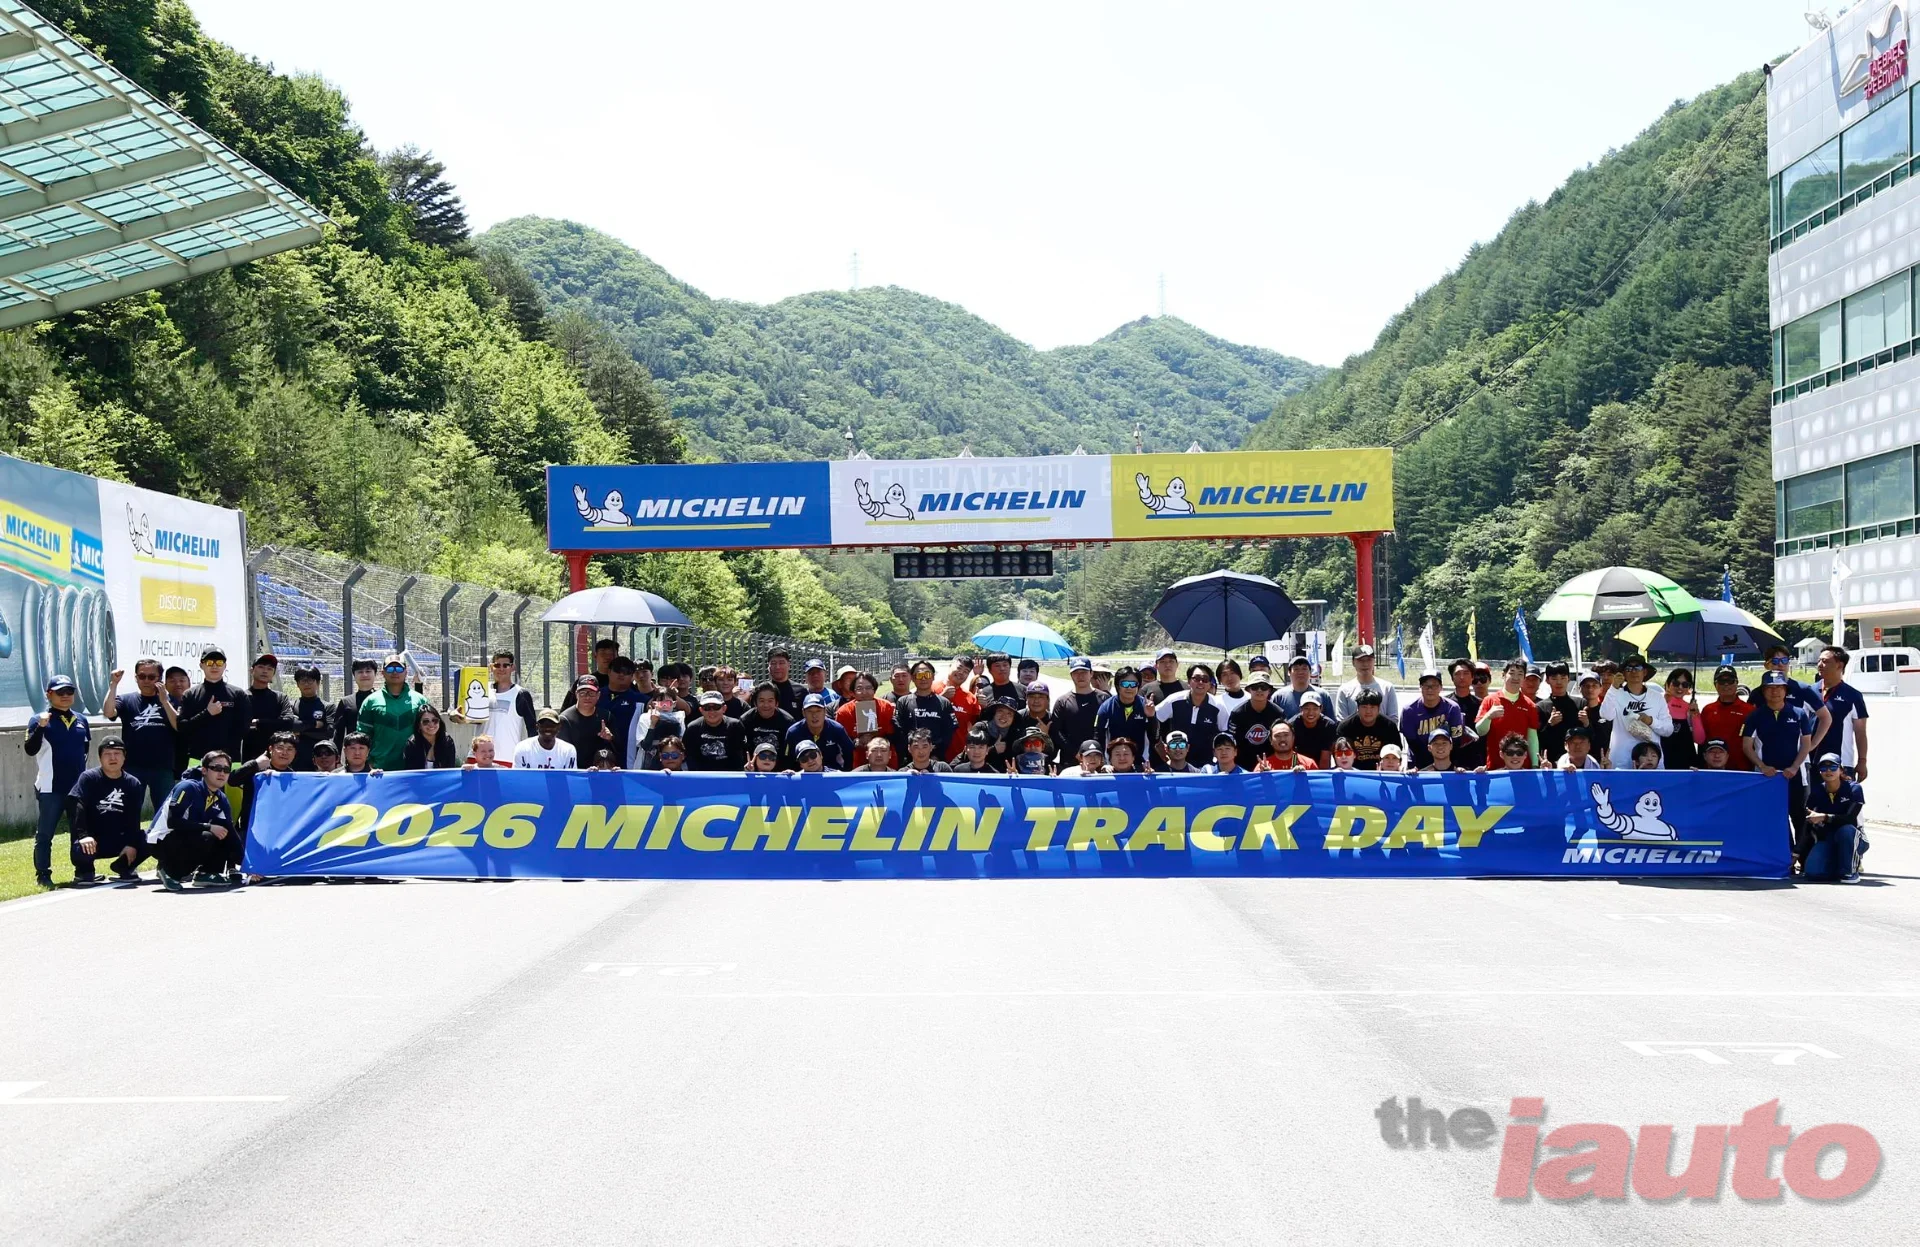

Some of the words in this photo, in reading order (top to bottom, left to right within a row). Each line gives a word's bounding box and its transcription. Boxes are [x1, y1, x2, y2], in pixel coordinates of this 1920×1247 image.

[917, 489, 1086, 513] MICHELIN
[1198, 482, 1368, 506] MICHELIN
[636, 496, 806, 519] MICHELIN
[6, 513, 61, 553] MICHELIN
[155, 529, 220, 559] MICHELIN
[159, 593, 198, 613] DISCOVER
[140, 639, 183, 657] MICHELIN
[1627, 701, 1647, 710] NIKE
[316, 802, 544, 849] 2026
[555, 803, 1004, 851] MICHELIN
[1024, 804, 1311, 852] TRACK
[1322, 805, 1513, 850] DAY
[1562, 848, 1722, 865] MICHELIN
